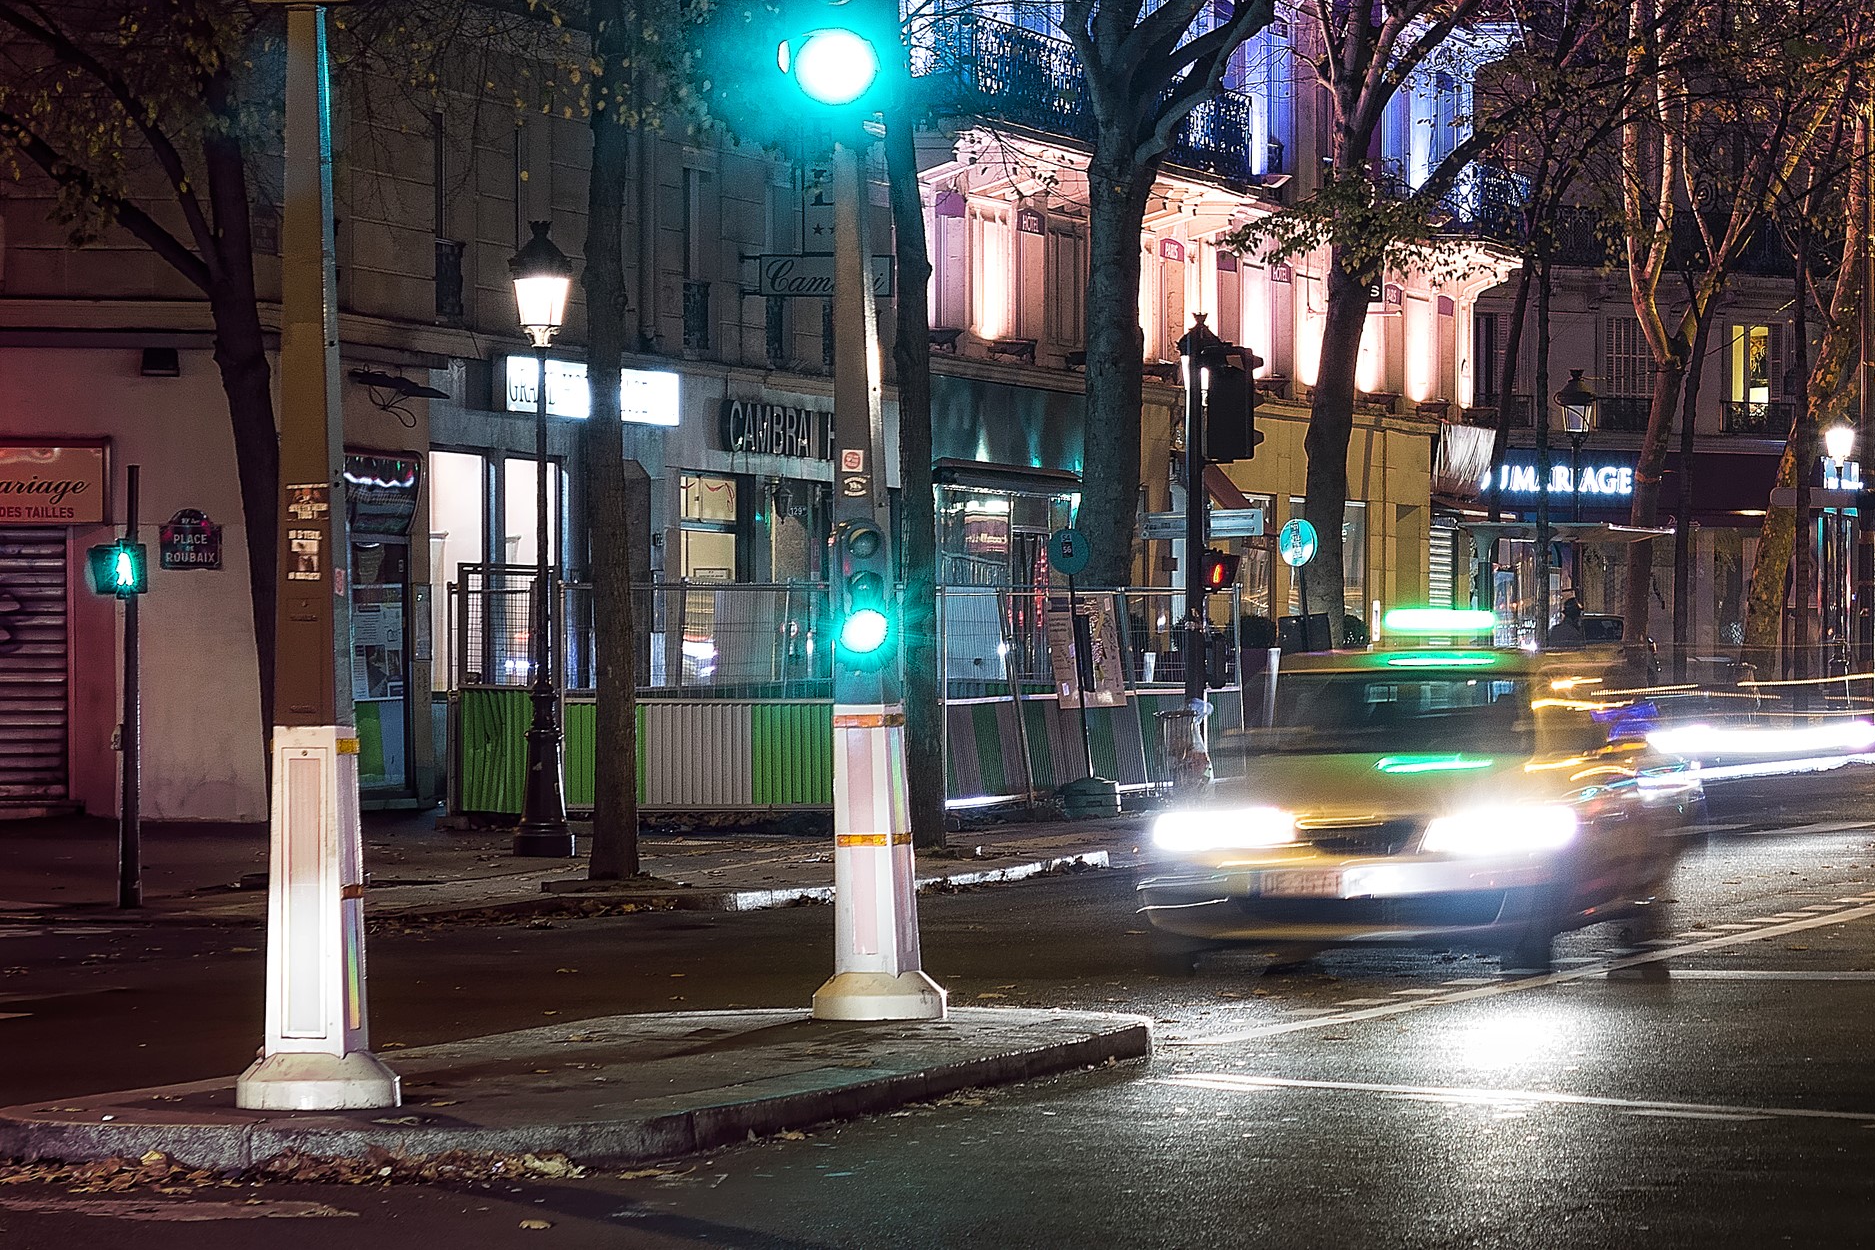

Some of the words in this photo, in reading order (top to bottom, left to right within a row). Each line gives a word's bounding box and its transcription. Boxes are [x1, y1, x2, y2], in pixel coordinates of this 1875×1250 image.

[1022, 212, 1039, 233] HÔTEL
[1165, 241, 1179, 260] PARIS
[765, 259, 885, 293] Cami
[1272, 264, 1288, 282] HÔTEL
[730, 400, 813, 457] CAMBRAI
[0, 475, 90, 505] ariage
[27, 506, 74, 519] TAILLES
[173, 533, 208, 545] PLACE
[165, 552, 216, 563] ROUBAIX
